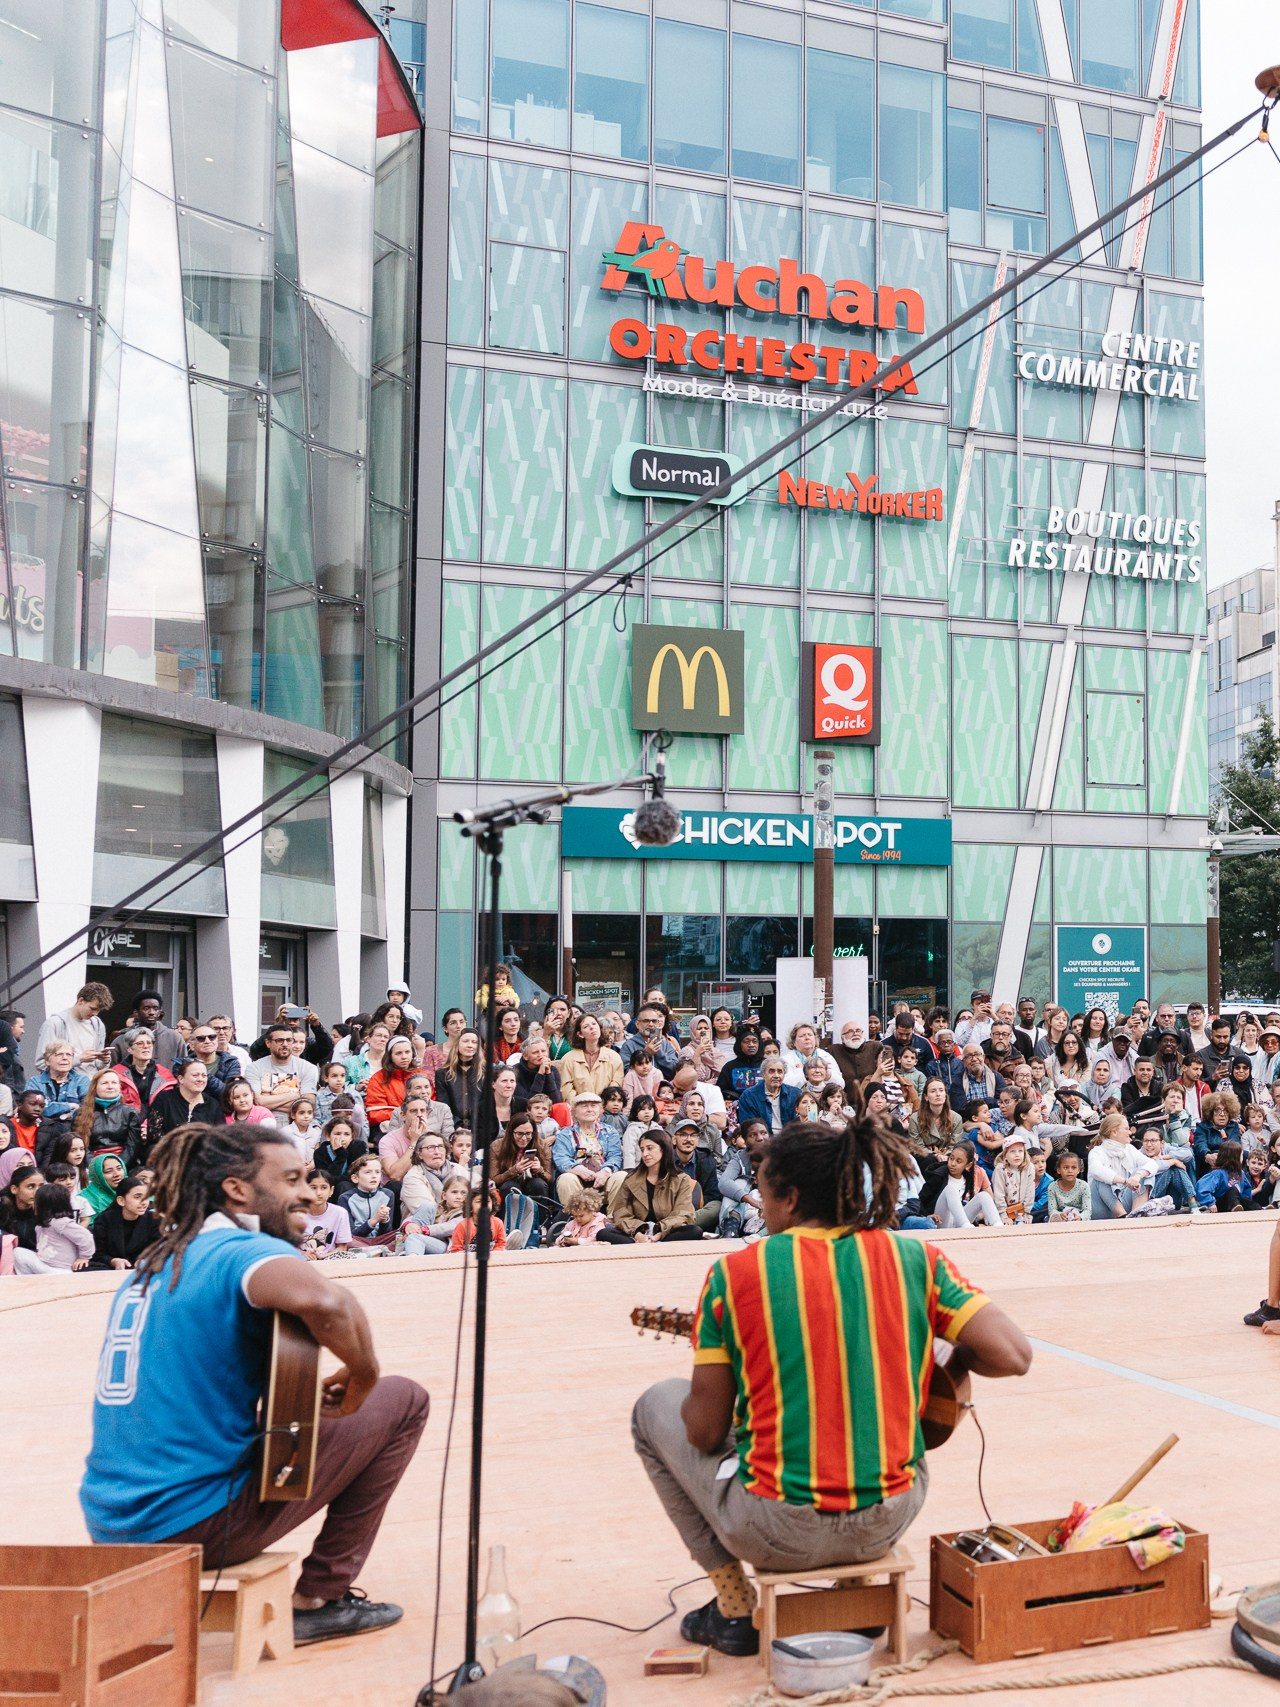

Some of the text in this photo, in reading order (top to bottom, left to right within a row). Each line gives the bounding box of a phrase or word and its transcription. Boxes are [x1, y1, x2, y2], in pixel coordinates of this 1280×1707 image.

[600, 221, 925, 334] Auchan
[609, 317, 919, 395] ORCHESTRA
[1101, 330, 1201, 369] CENTRE
[642, 370, 714, 399] Mode
[721, 381, 740, 401] &
[1018, 351, 1201, 401] COMMERCIAL
[642, 457, 720, 487] Normal
[1047, 505, 1201, 547] BOUTIQUES
[1007, 538, 1201, 583] RESTAURANTS
[820, 653, 869, 712] Q
[821, 713, 867, 733] Quick
[833, 821, 902, 850] POT
[859, 849, 902, 861] Since 1994
[810, 943, 864, 958] vert
[96, 1282, 154, 1406] 8
